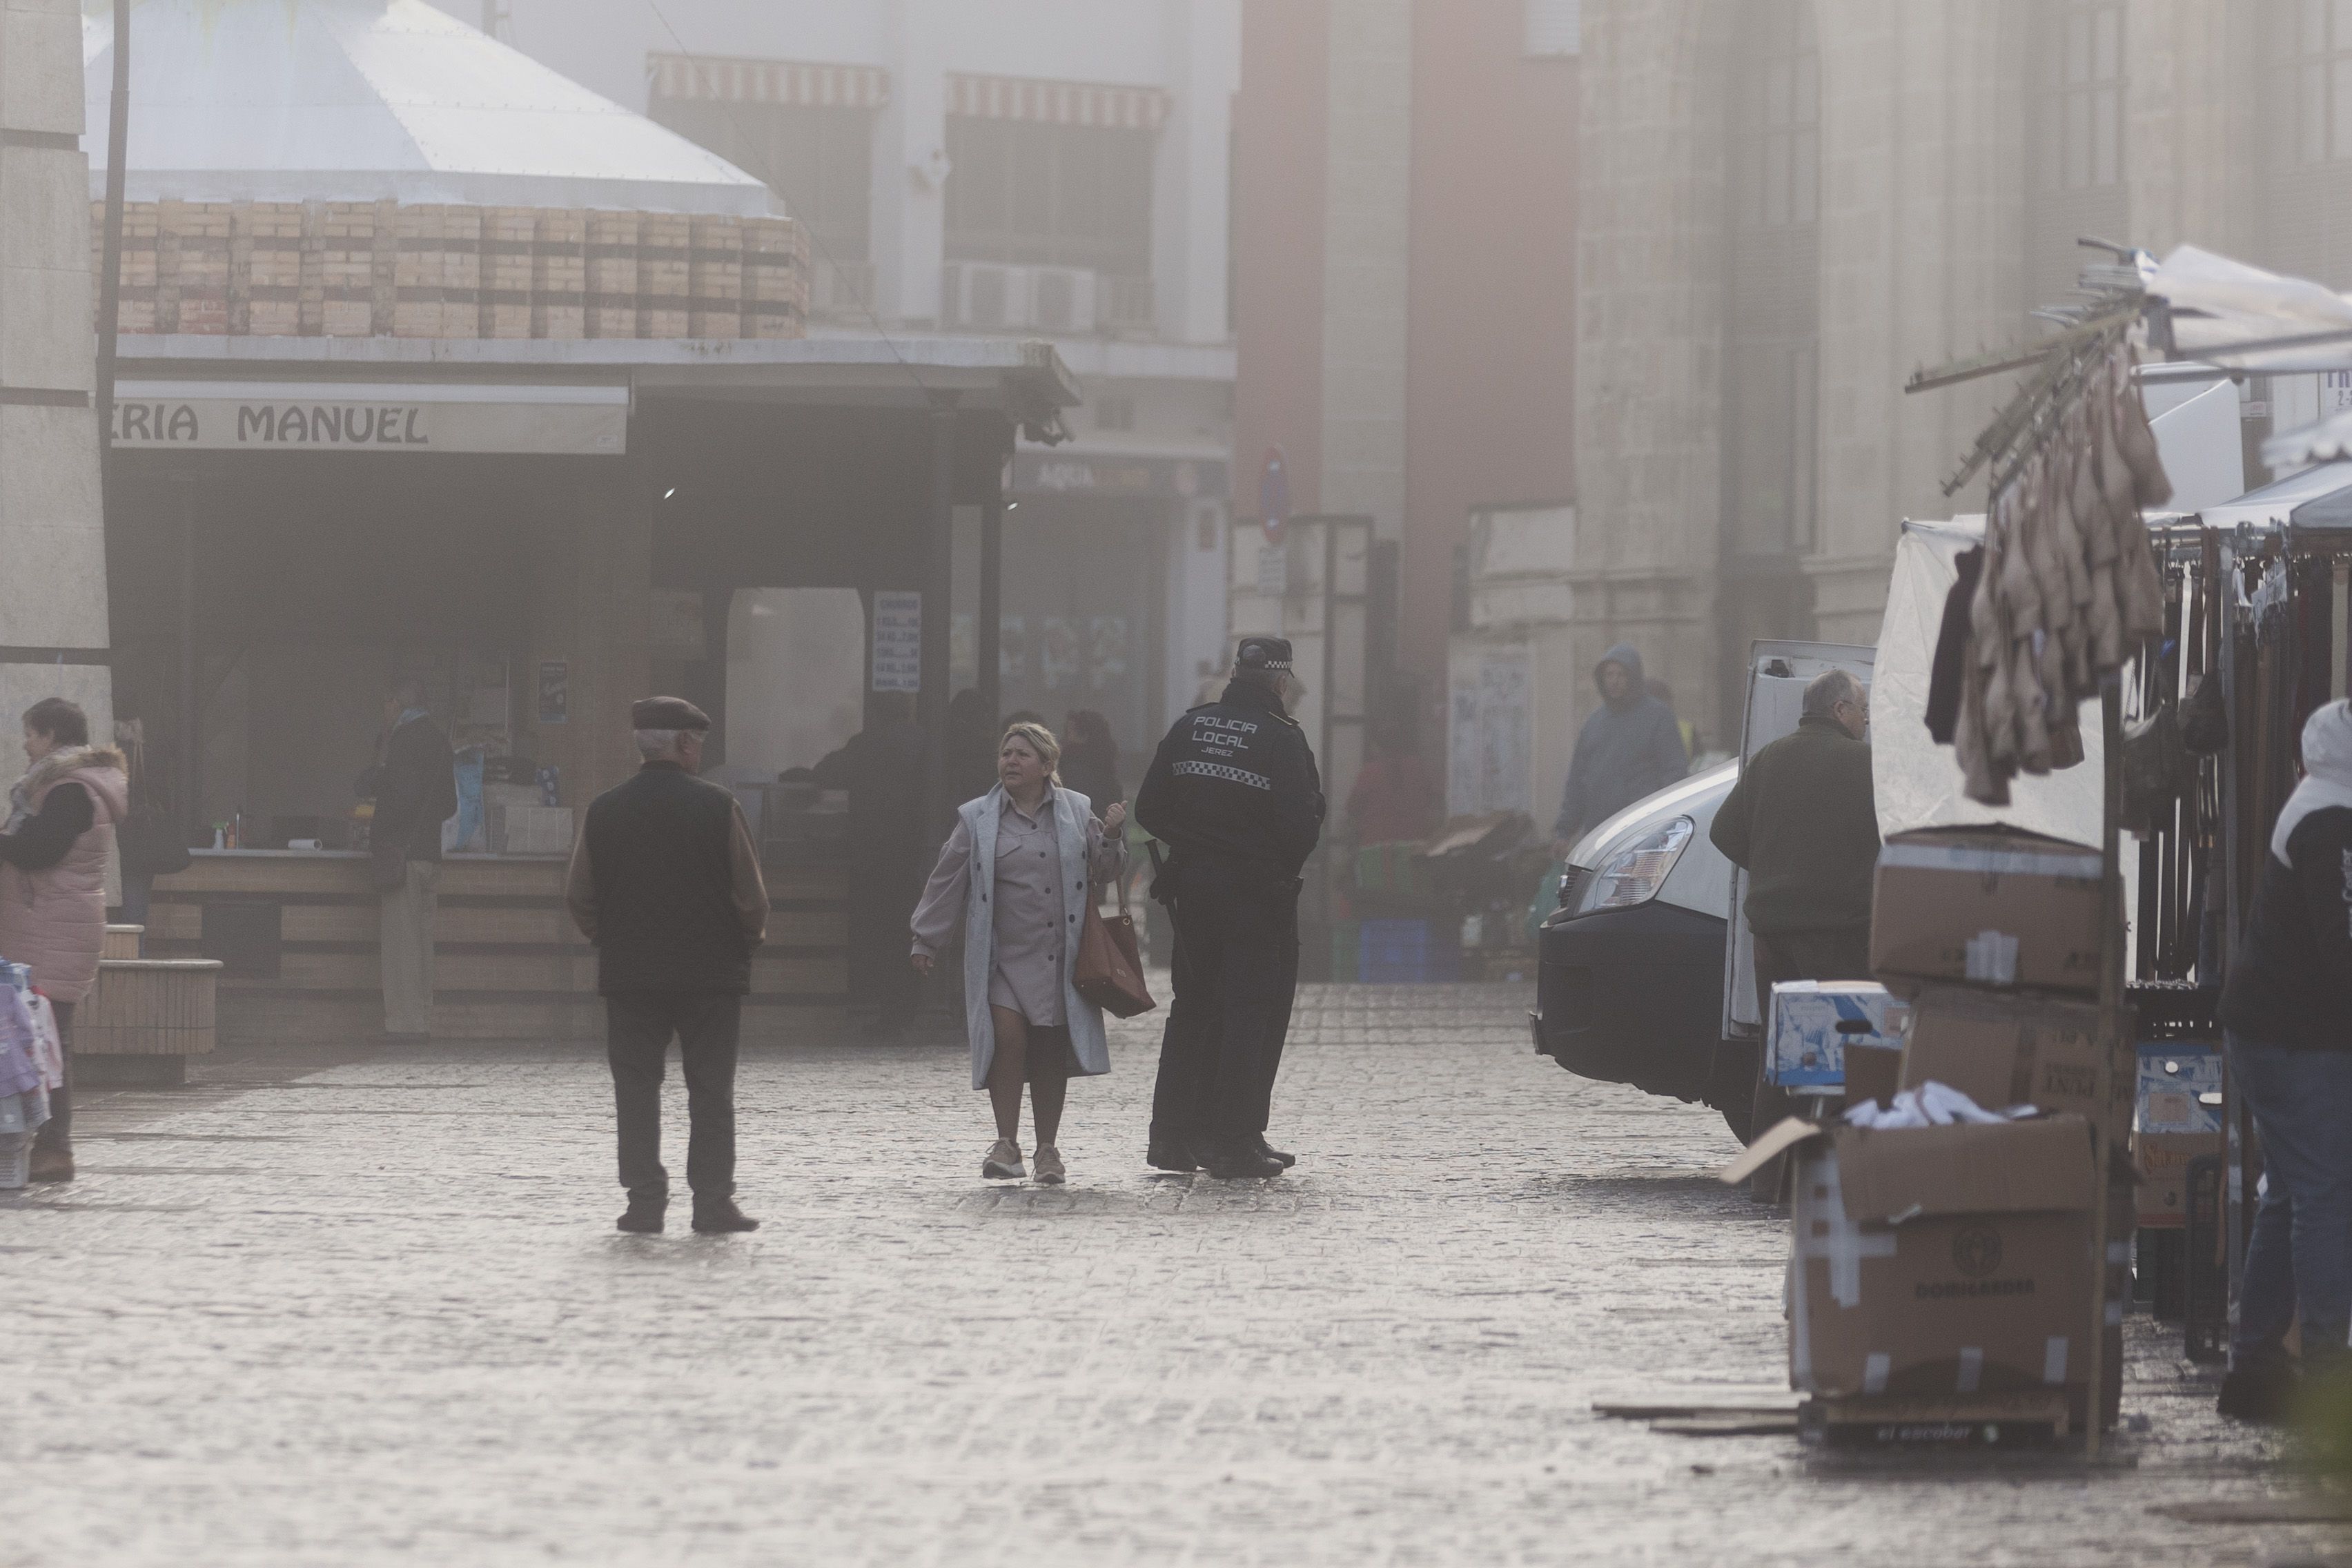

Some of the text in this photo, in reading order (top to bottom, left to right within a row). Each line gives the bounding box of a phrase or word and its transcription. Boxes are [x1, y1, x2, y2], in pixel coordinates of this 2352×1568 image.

[237, 405, 429, 444] MANUEL
[1193, 716, 1258, 734] POLICIA
[1192, 730, 1248, 749] LOCAL
[1201, 747, 1233, 757] JEREZ
